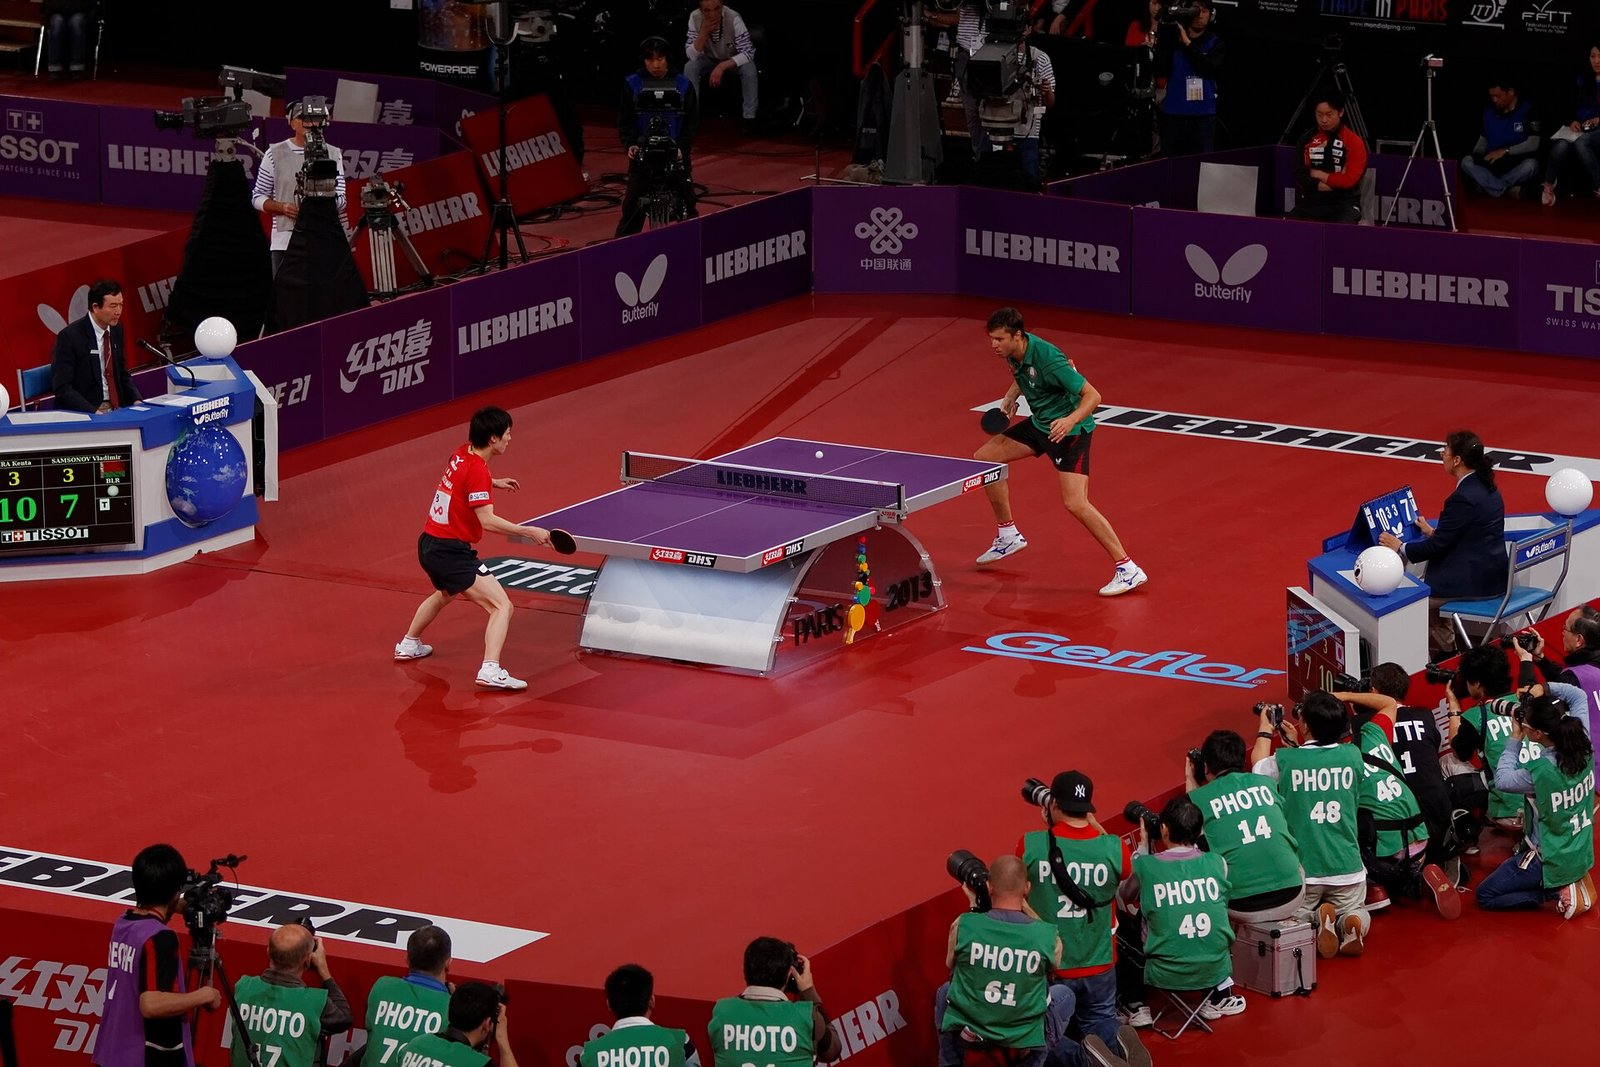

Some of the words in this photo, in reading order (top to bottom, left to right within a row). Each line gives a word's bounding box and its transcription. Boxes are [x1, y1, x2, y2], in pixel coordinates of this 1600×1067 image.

[1522, 10, 1572, 23] FFTT
[420, 61, 477, 75] POWERADE
[705, 229, 807, 285] LIEBHERR
[965, 228, 1121, 273] LIEBHERR
[860, 258, 912, 271] 中国联通
[1194, 282, 1252, 304] Butterfly
[1332, 267, 1510, 308] LIEBHERR
[458, 297, 574, 356] LIEBHERR
[622, 301, 660, 325] Butterfly
[1545, 316, 1577, 329] SWISS
[288, 374, 312, 406] 21
[380, 359, 431, 396] DHS
[192, 396, 230, 416] LIEBHERR
[51, 456, 92, 465] SAMSONOV
[9, 471, 21, 486] 3
[63, 468, 75, 483] 3
[716, 469, 808, 496] LIEBHERR
[0, 496, 37, 523] 10
[60, 494, 79, 519] 7
[1400, 499, 1412, 522] 7
[26, 527, 88, 541] TISSOT
[687, 553, 715, 567] DHS
[794, 603, 844, 646] PARIS
[986, 632, 1287, 682] Gerflor
[1400, 750, 1417, 774] 1
[1291, 766, 1354, 792] PHOTO
[1376, 774, 1403, 802] 46
[1550, 770, 1595, 813] PHOTO
[1210, 785, 1275, 819] PHOTO
[1309, 800, 1341, 824] 48
[1237, 815, 1272, 844] 14
[1039, 860, 1109, 887] POTO
[1153, 877, 1220, 908] PHOTO
[1178, 912, 1212, 939] 49
[969, 942, 1041, 974] PHOTO
[984, 980, 1017, 1007] 61
[240, 1003, 305, 1038] PHOTO
[374, 1000, 442, 1034] PHOTO
[723, 1024, 798, 1053] PHOTO
